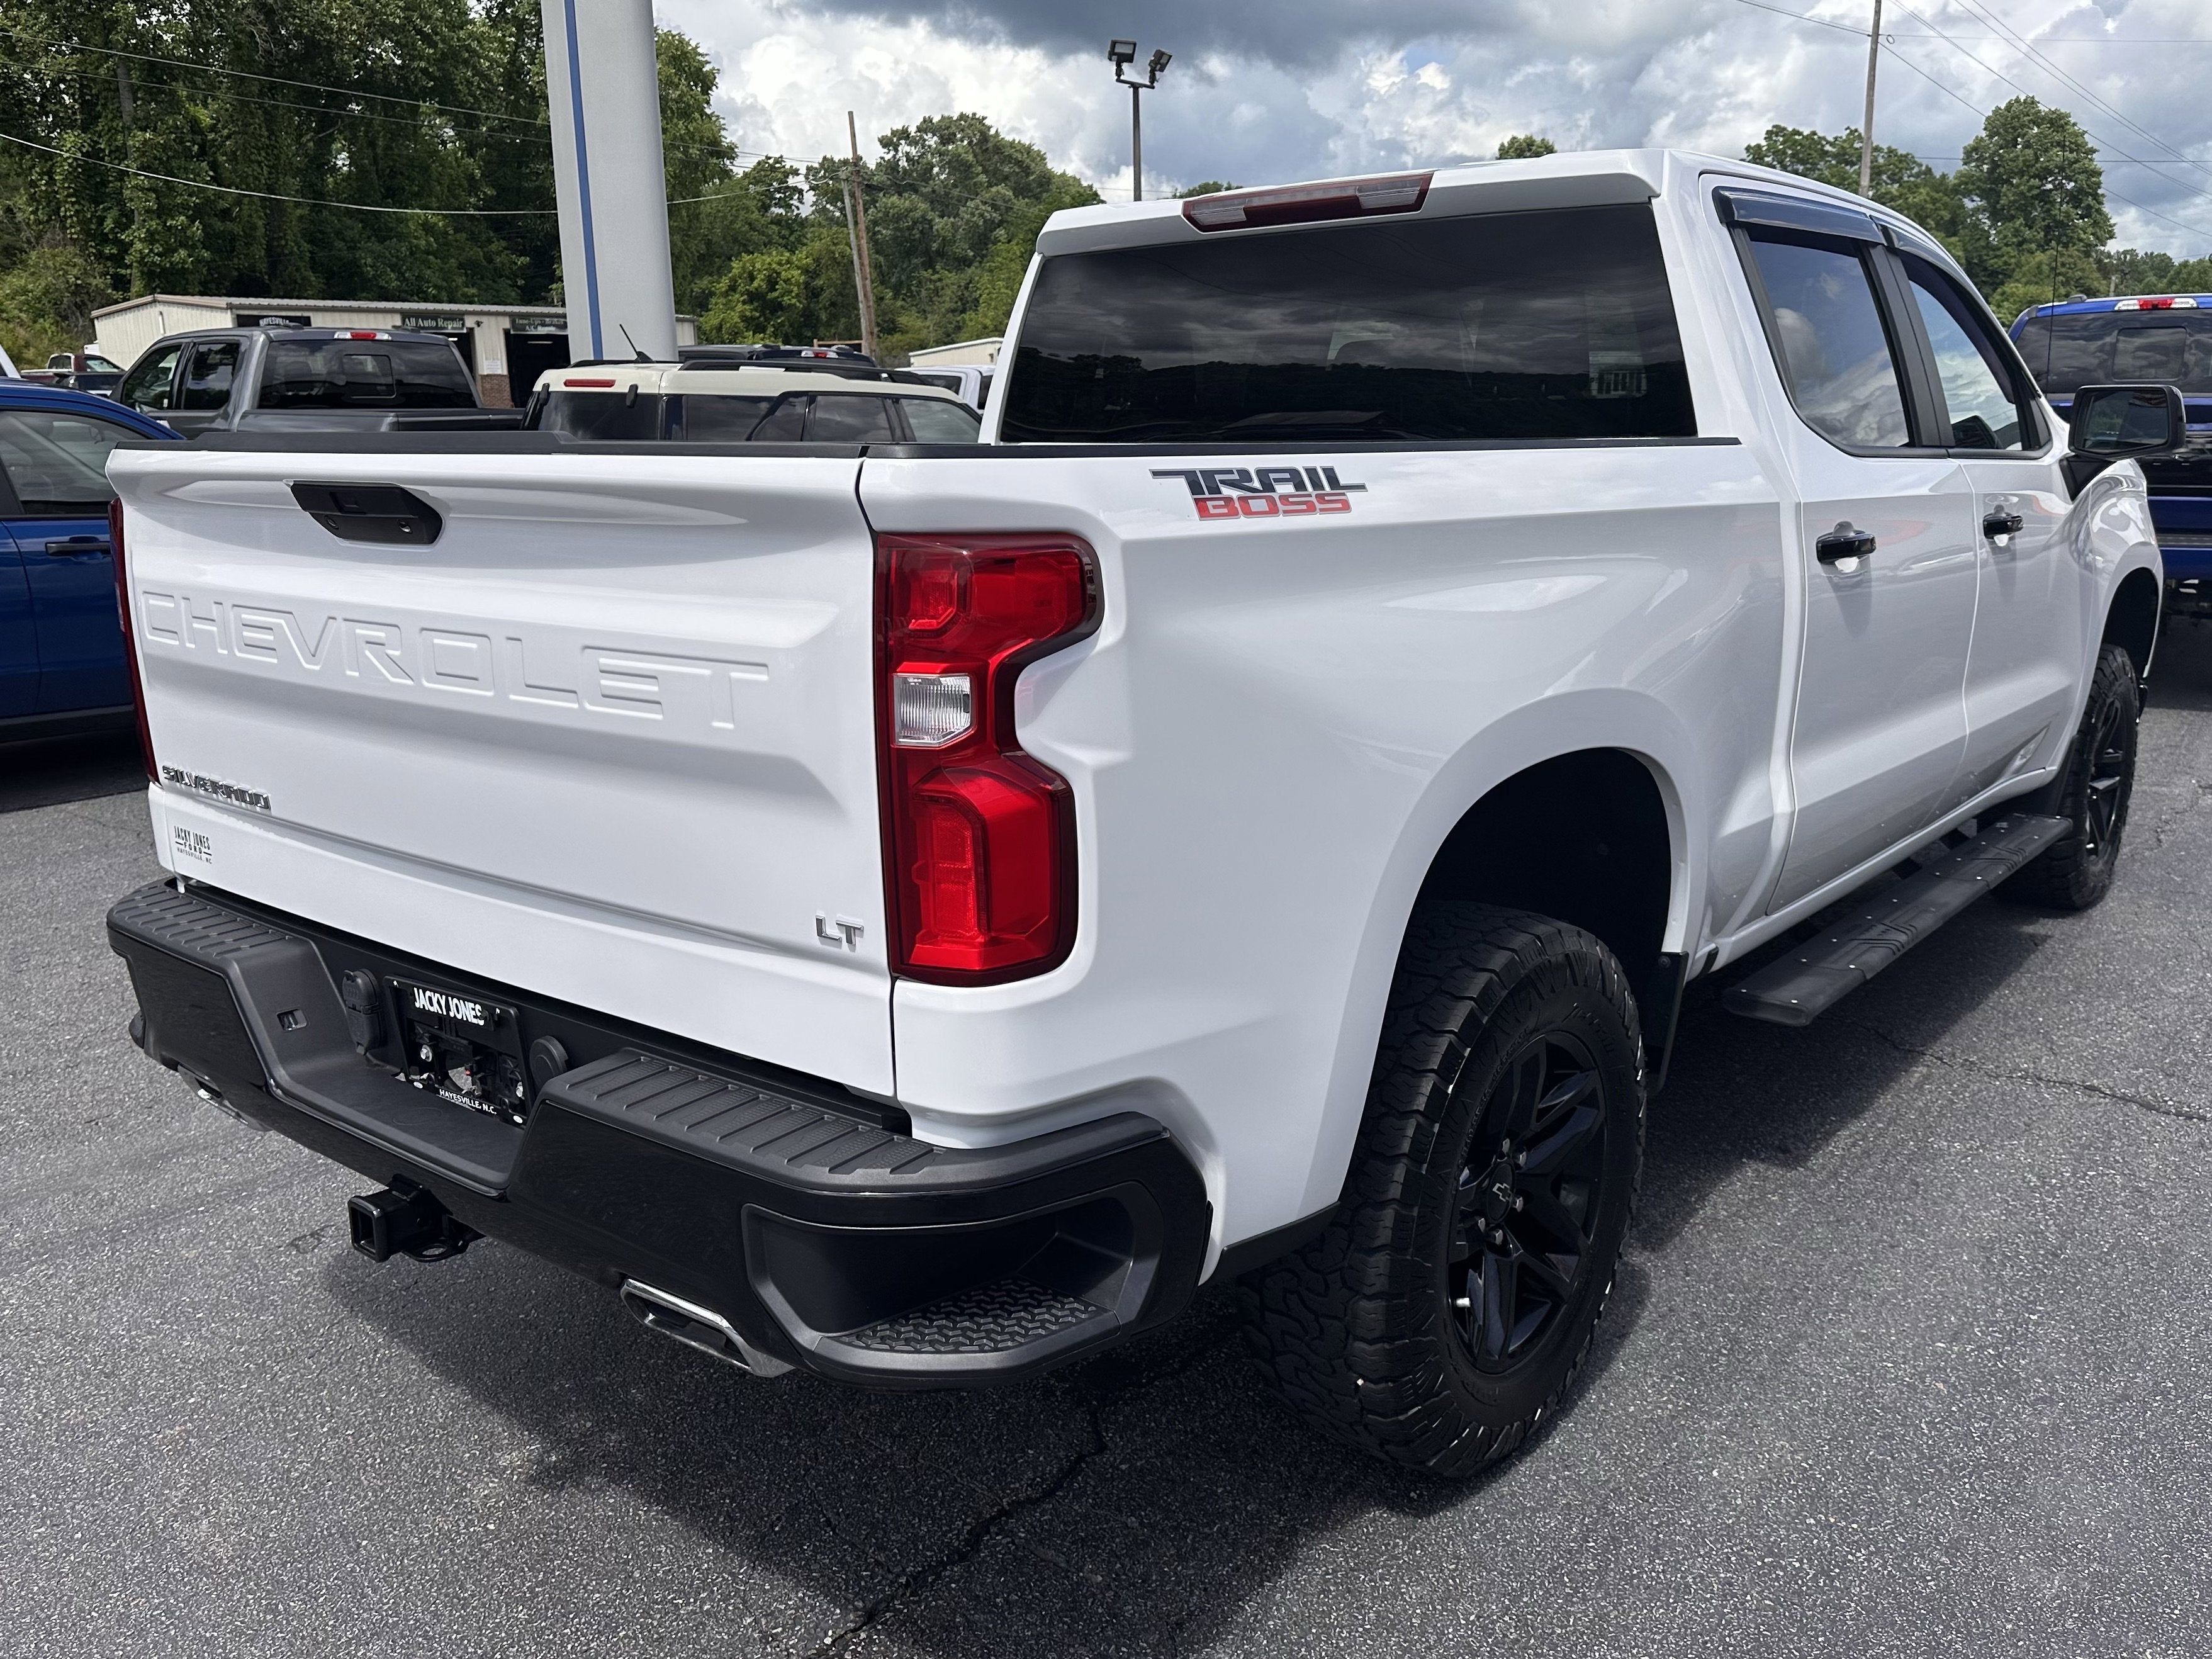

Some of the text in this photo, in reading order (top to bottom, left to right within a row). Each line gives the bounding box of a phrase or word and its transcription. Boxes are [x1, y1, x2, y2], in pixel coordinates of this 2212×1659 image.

[404, 317, 463, 329] All Auto Repair
[1148, 466, 1368, 496] TRAIL
[1192, 492, 1352, 521] BOSS
[142, 590, 769, 729] CHEVROLET
[162, 765, 271, 809] SILVERADO
[174, 826, 210, 850] JACKY JONES
[184, 841, 202, 855] FORD
[815, 914, 864, 945] LT
[413, 987, 485, 1026] JACKY JONES
[439, 1089, 497, 1115] HAYESVILLE, N.C.
